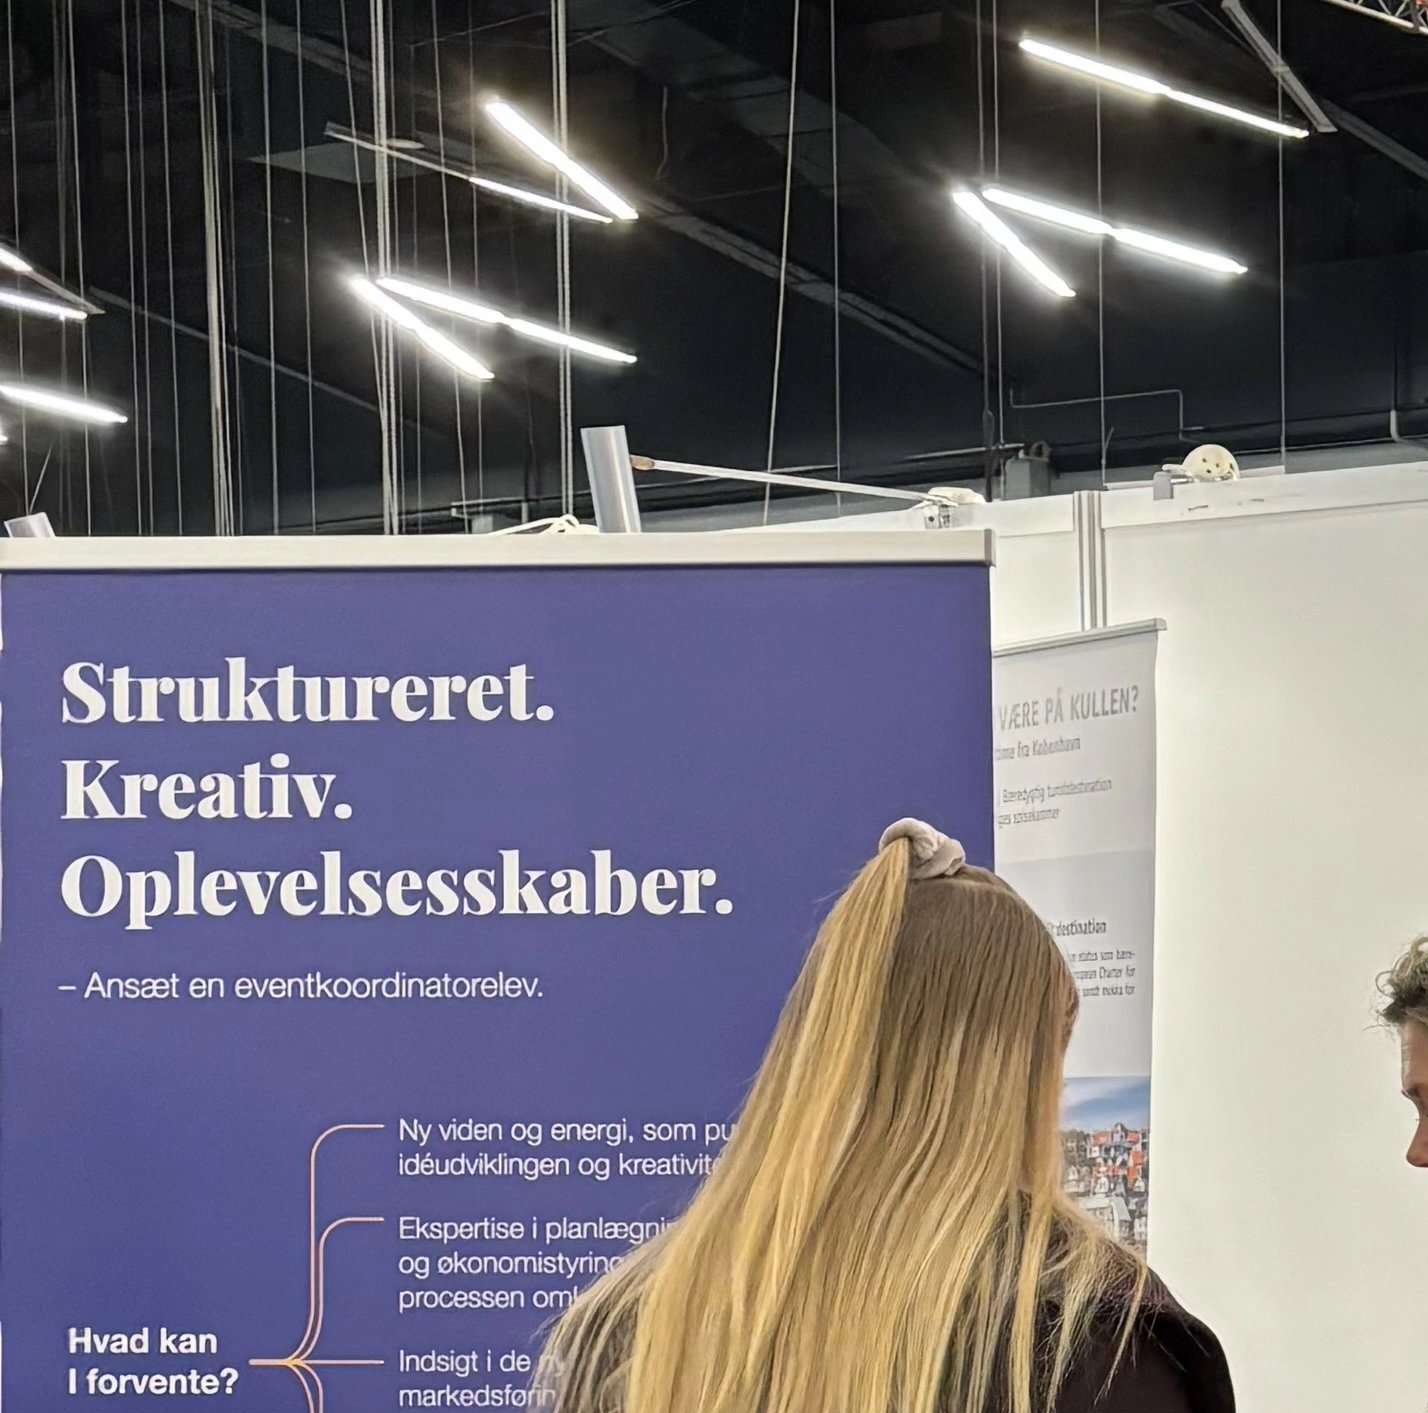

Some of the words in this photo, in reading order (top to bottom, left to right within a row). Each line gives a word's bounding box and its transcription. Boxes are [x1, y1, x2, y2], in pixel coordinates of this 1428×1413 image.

[61, 656, 554, 724] Struktureret.
[1045, 687, 1065, 725] PÅ
[1070, 685, 1140, 720] KULLEN?
[60, 752, 353, 820] Kreativ.
[61, 849, 733, 930] Oplevelsesskaber.
[83, 971, 180, 999] Ansæt
[188, 977, 225, 999] en
[234, 971, 543, 999] eventkoordinatorelev.
[399, 1118, 433, 1147] Ny
[438, 1118, 503, 1141] viden
[510, 1122, 543, 1147] og
[550, 1117, 634, 1147] energi,
[642, 1123, 696, 1141] som
[399, 1152, 570, 1181] idéudviklingen
[577, 1157, 610, 1181] og
[399, 1216, 525, 1245] Ekspertise
[398, 1256, 430, 1280] og
[399, 1290, 525, 1314] processen
[68, 1326, 149, 1354] Hvad
[159, 1327, 218, 1354] kan
[399, 1349, 479, 1378] Indsigt
[499, 1349, 532, 1373] de
[86, 1367, 239, 1395] forvente?
